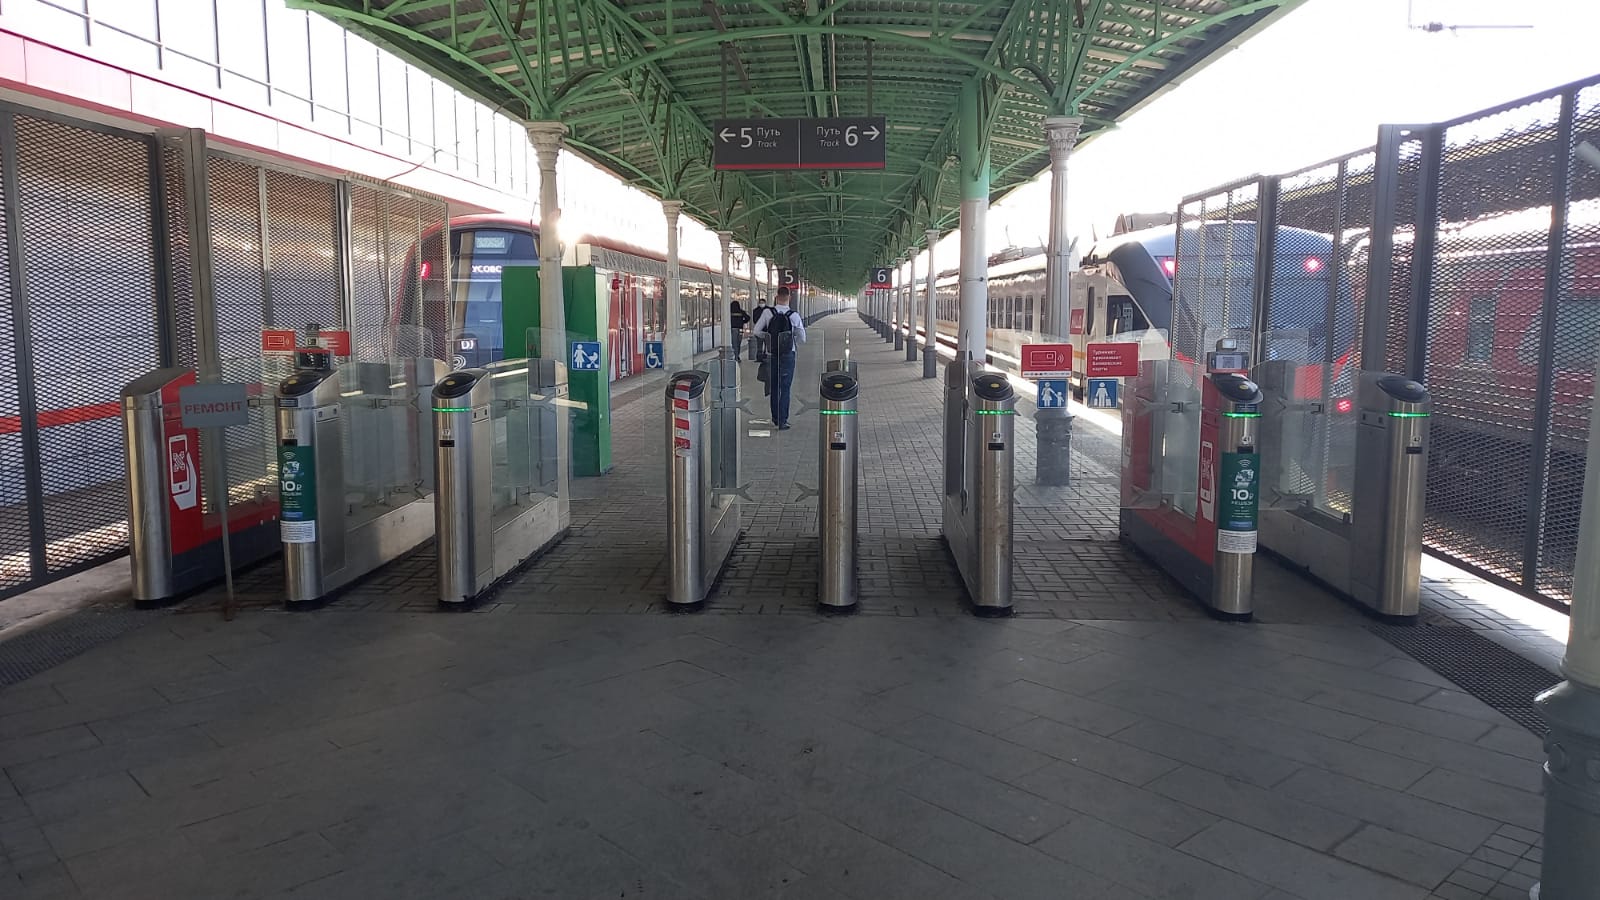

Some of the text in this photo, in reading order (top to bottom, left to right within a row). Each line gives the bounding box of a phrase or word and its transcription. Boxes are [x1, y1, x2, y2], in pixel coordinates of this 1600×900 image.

[740, 127, 781, 148] 5 Путь
[816, 125, 859, 147] Путь 6
[820, 139, 840, 147] Track
[757, 140, 777, 148] Track
[784, 269, 794, 284] 5
[877, 269, 886, 283] 6
[184, 401, 243, 415] РЕМОНТ
